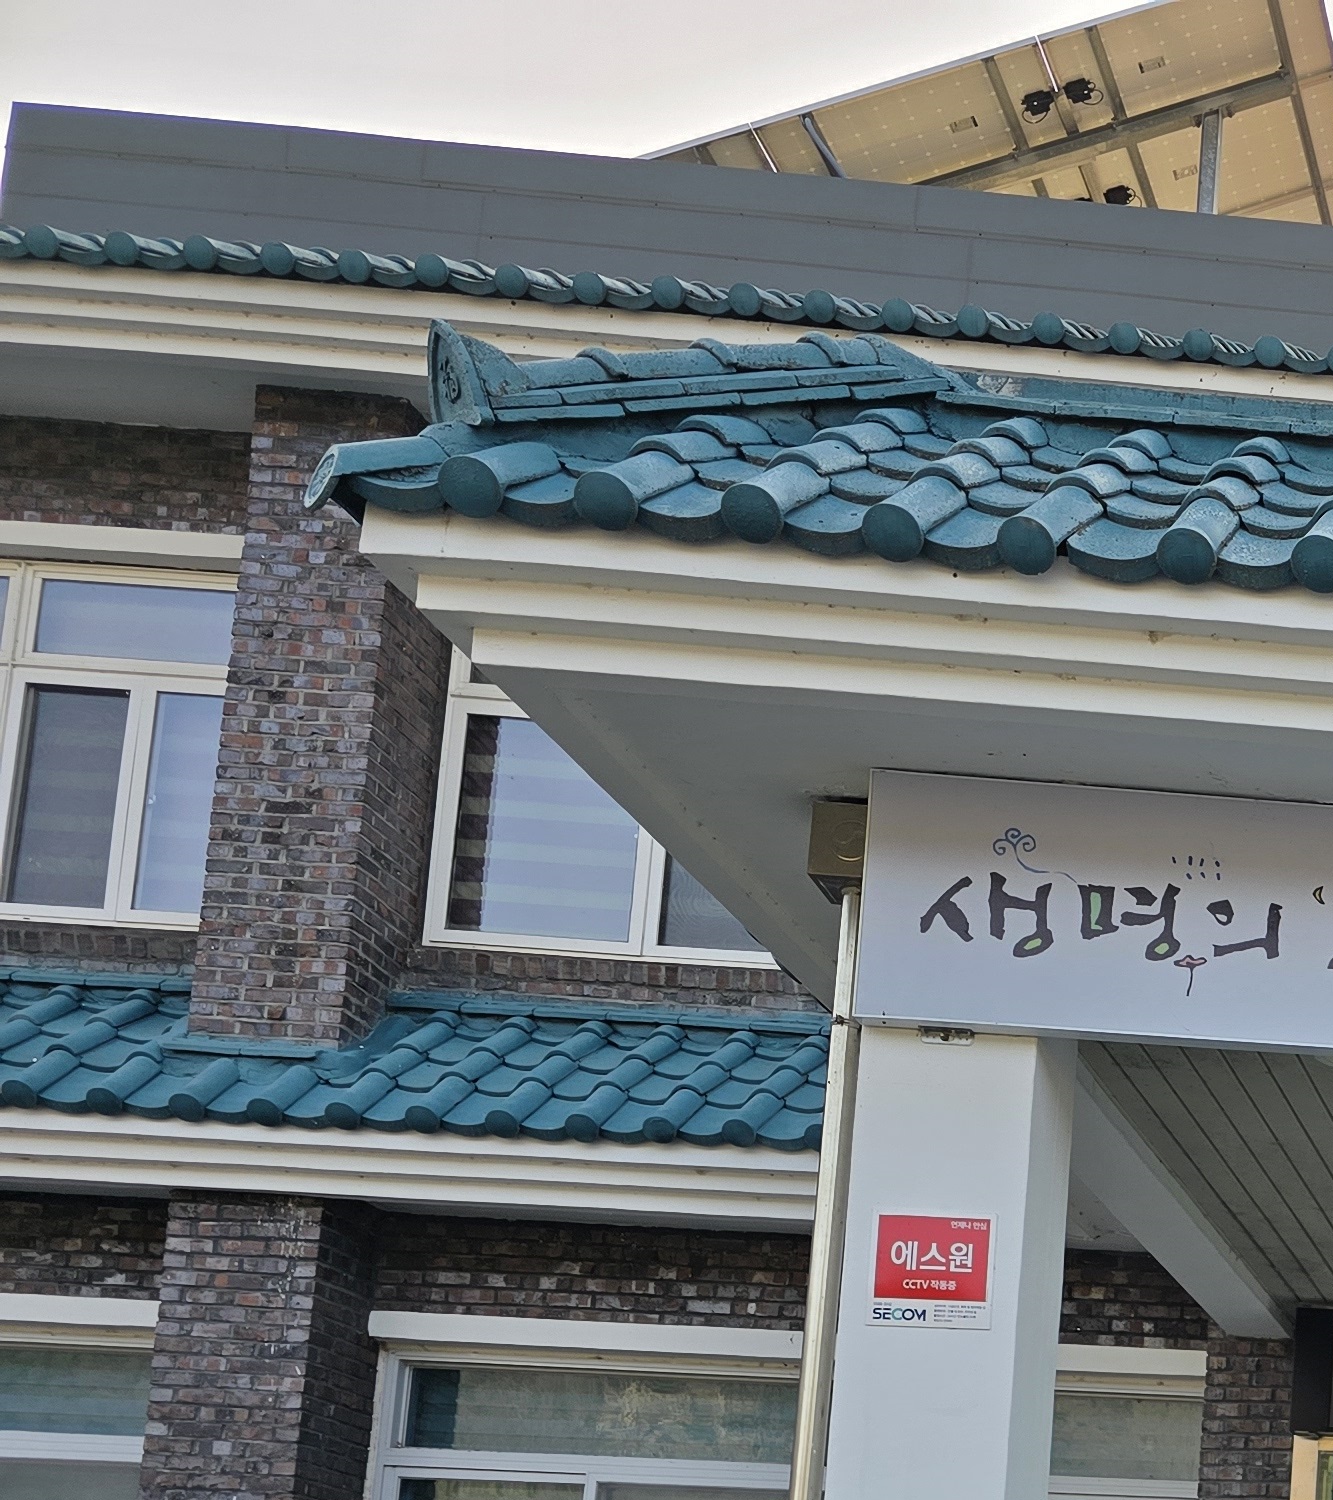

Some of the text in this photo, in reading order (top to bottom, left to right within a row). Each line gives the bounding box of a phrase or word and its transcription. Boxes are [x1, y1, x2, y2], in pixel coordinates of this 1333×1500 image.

[919, 871, 1284, 962] 생명의
[890, 1240, 974, 1273] 에스원
[902, 1278, 957, 1291] CCTV 작동중
[872, 1307, 927, 1322] SECOM
